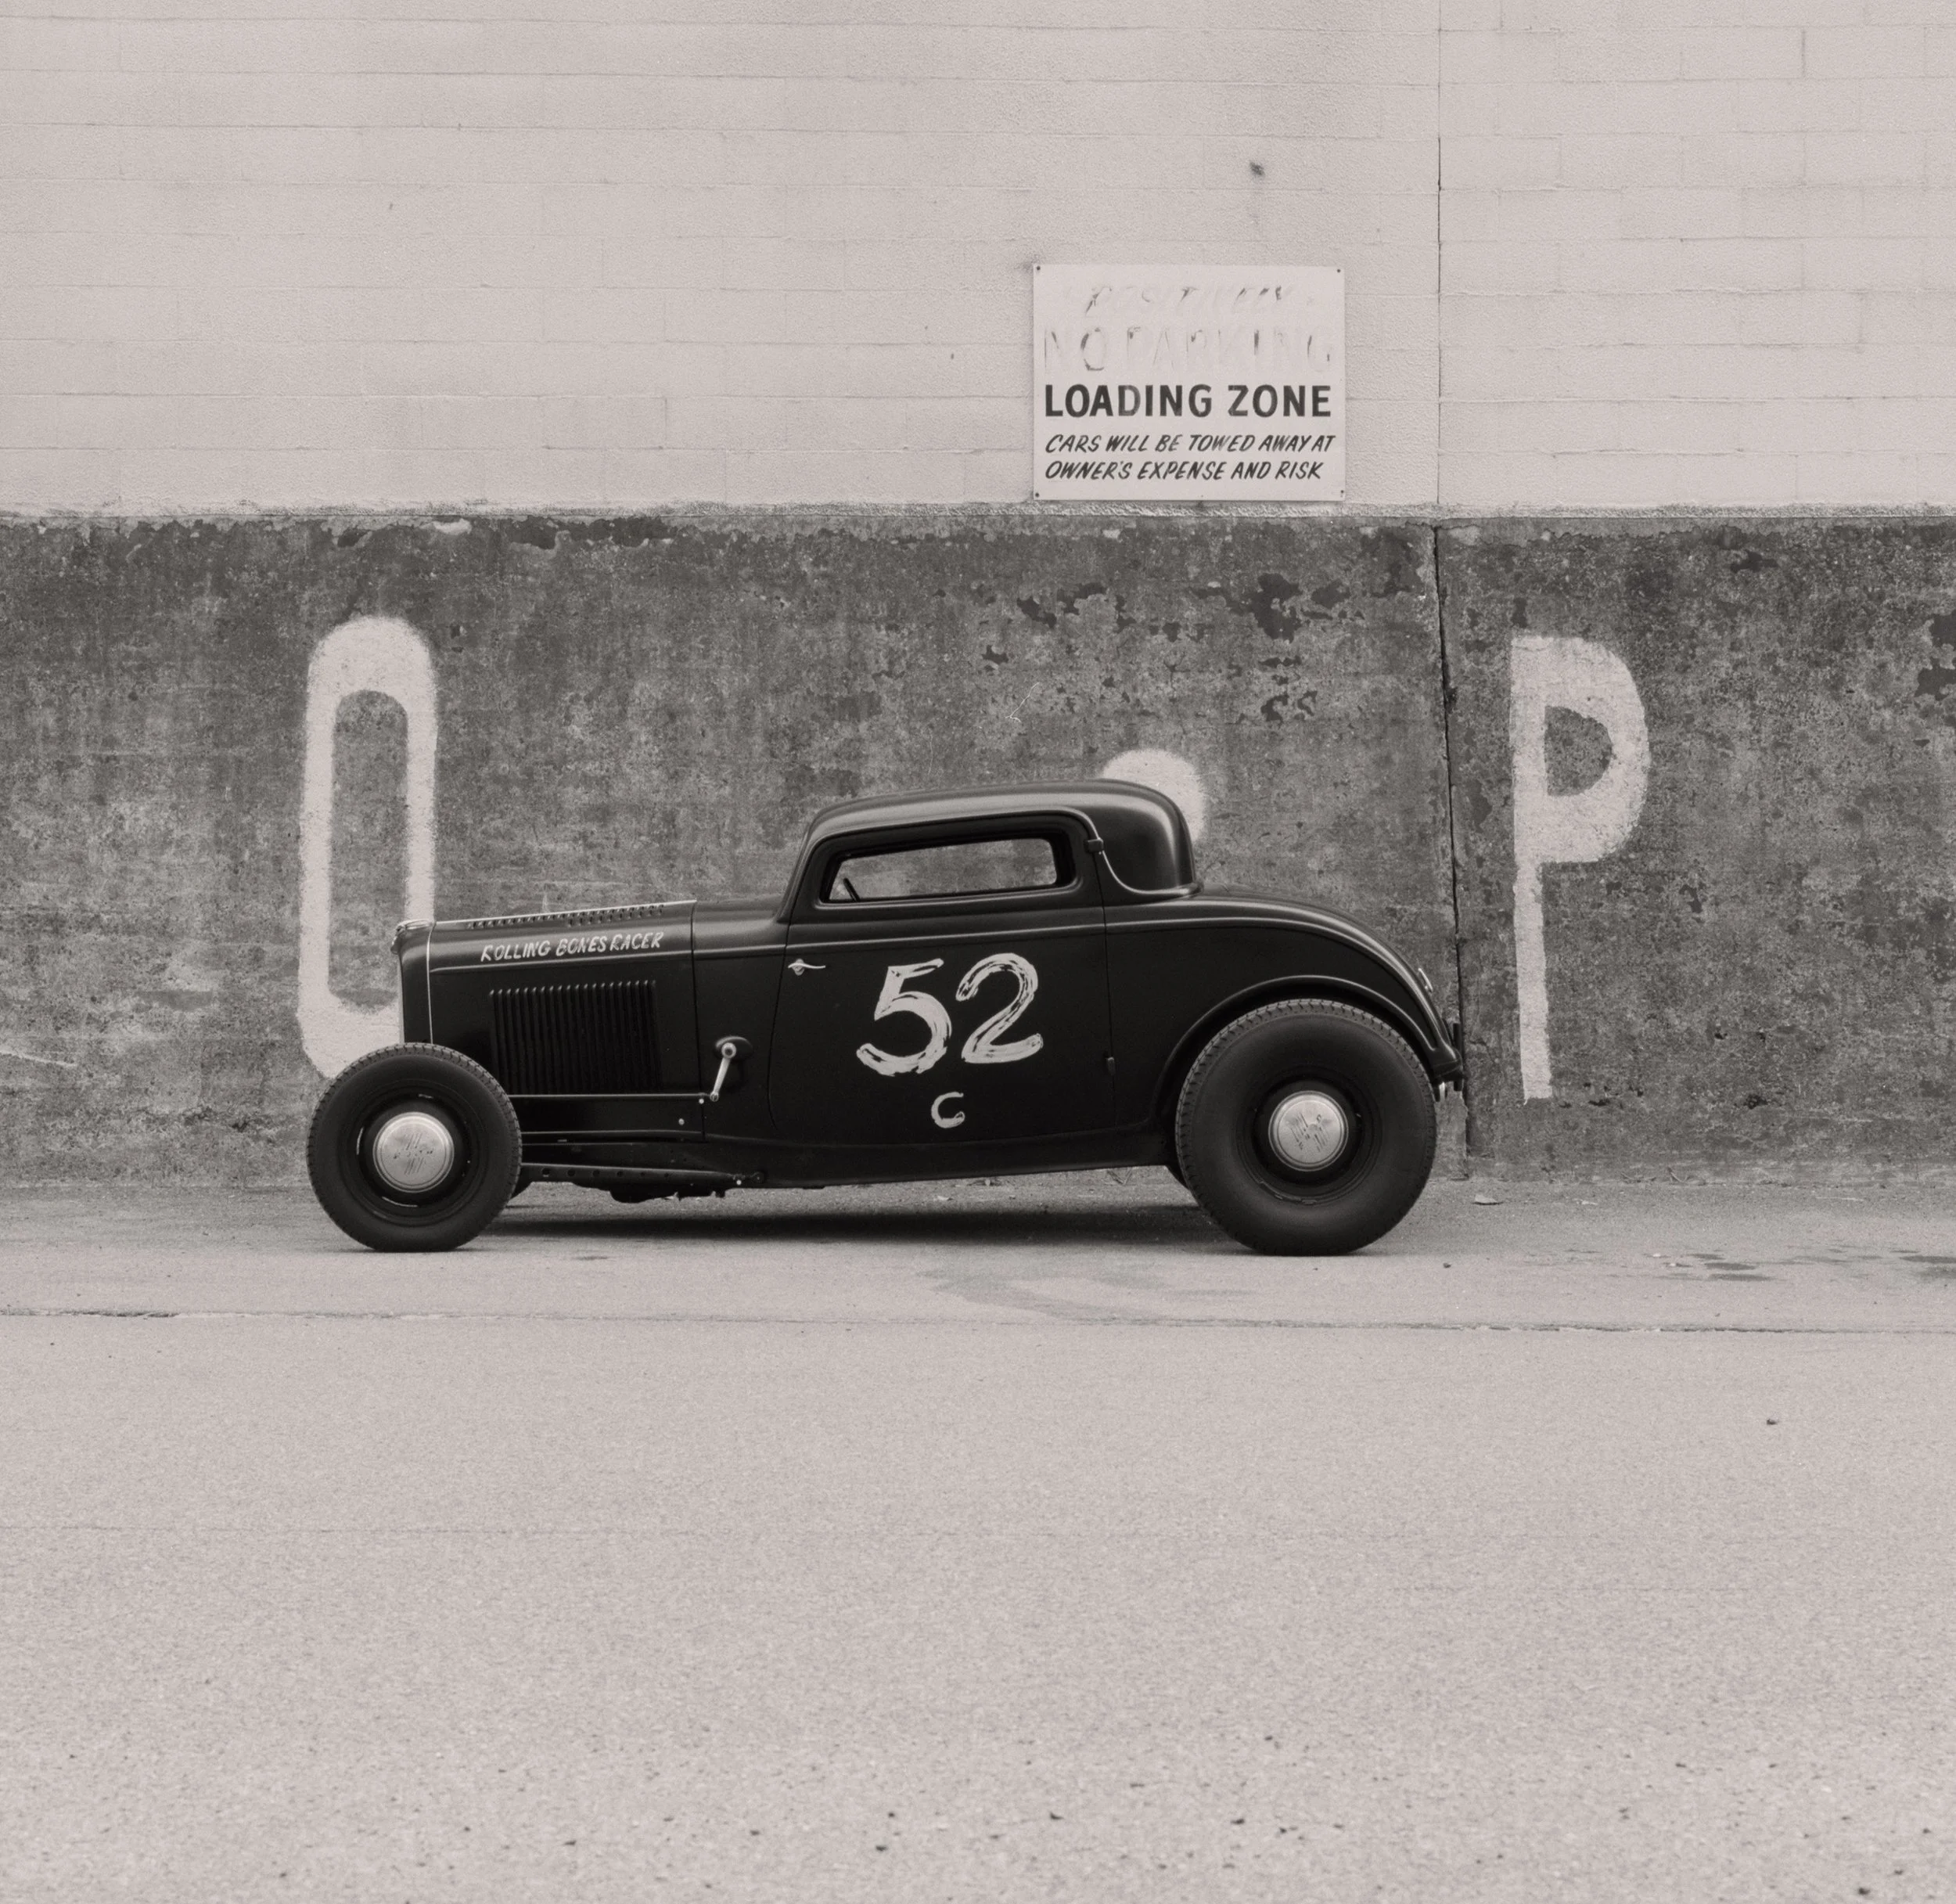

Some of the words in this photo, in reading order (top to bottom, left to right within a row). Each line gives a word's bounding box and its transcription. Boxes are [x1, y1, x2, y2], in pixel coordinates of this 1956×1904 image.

[1044, 326, 1109, 372] NO
[1125, 326, 1334, 373] PARKING
[1045, 383, 1213, 418] LOADING
[1227, 383, 1332, 418] ZONE
[1045, 434, 1102, 454] CARS
[1105, 434, 1150, 452] WILL
[1154, 434, 1183, 452] BE
[1188, 434, 1256, 452] TOWED
[1257, 434, 1312, 453] AWAY
[1311, 434, 1336, 452] AT
[1045, 460, 1133, 480] OWNER'S
[1137, 460, 1227, 480] EXPENSE
[1230, 461, 1271, 480] AND
[1275, 460, 1325, 480] RISK
[1508, 635, 1652, 1104] P
[480, 939, 552, 963] ROLLING
[555, 935, 608, 957] BONES
[609, 930, 665, 952] RACER
[856, 952, 1045, 1078] 52
[930, 1091, 965, 1129] C
